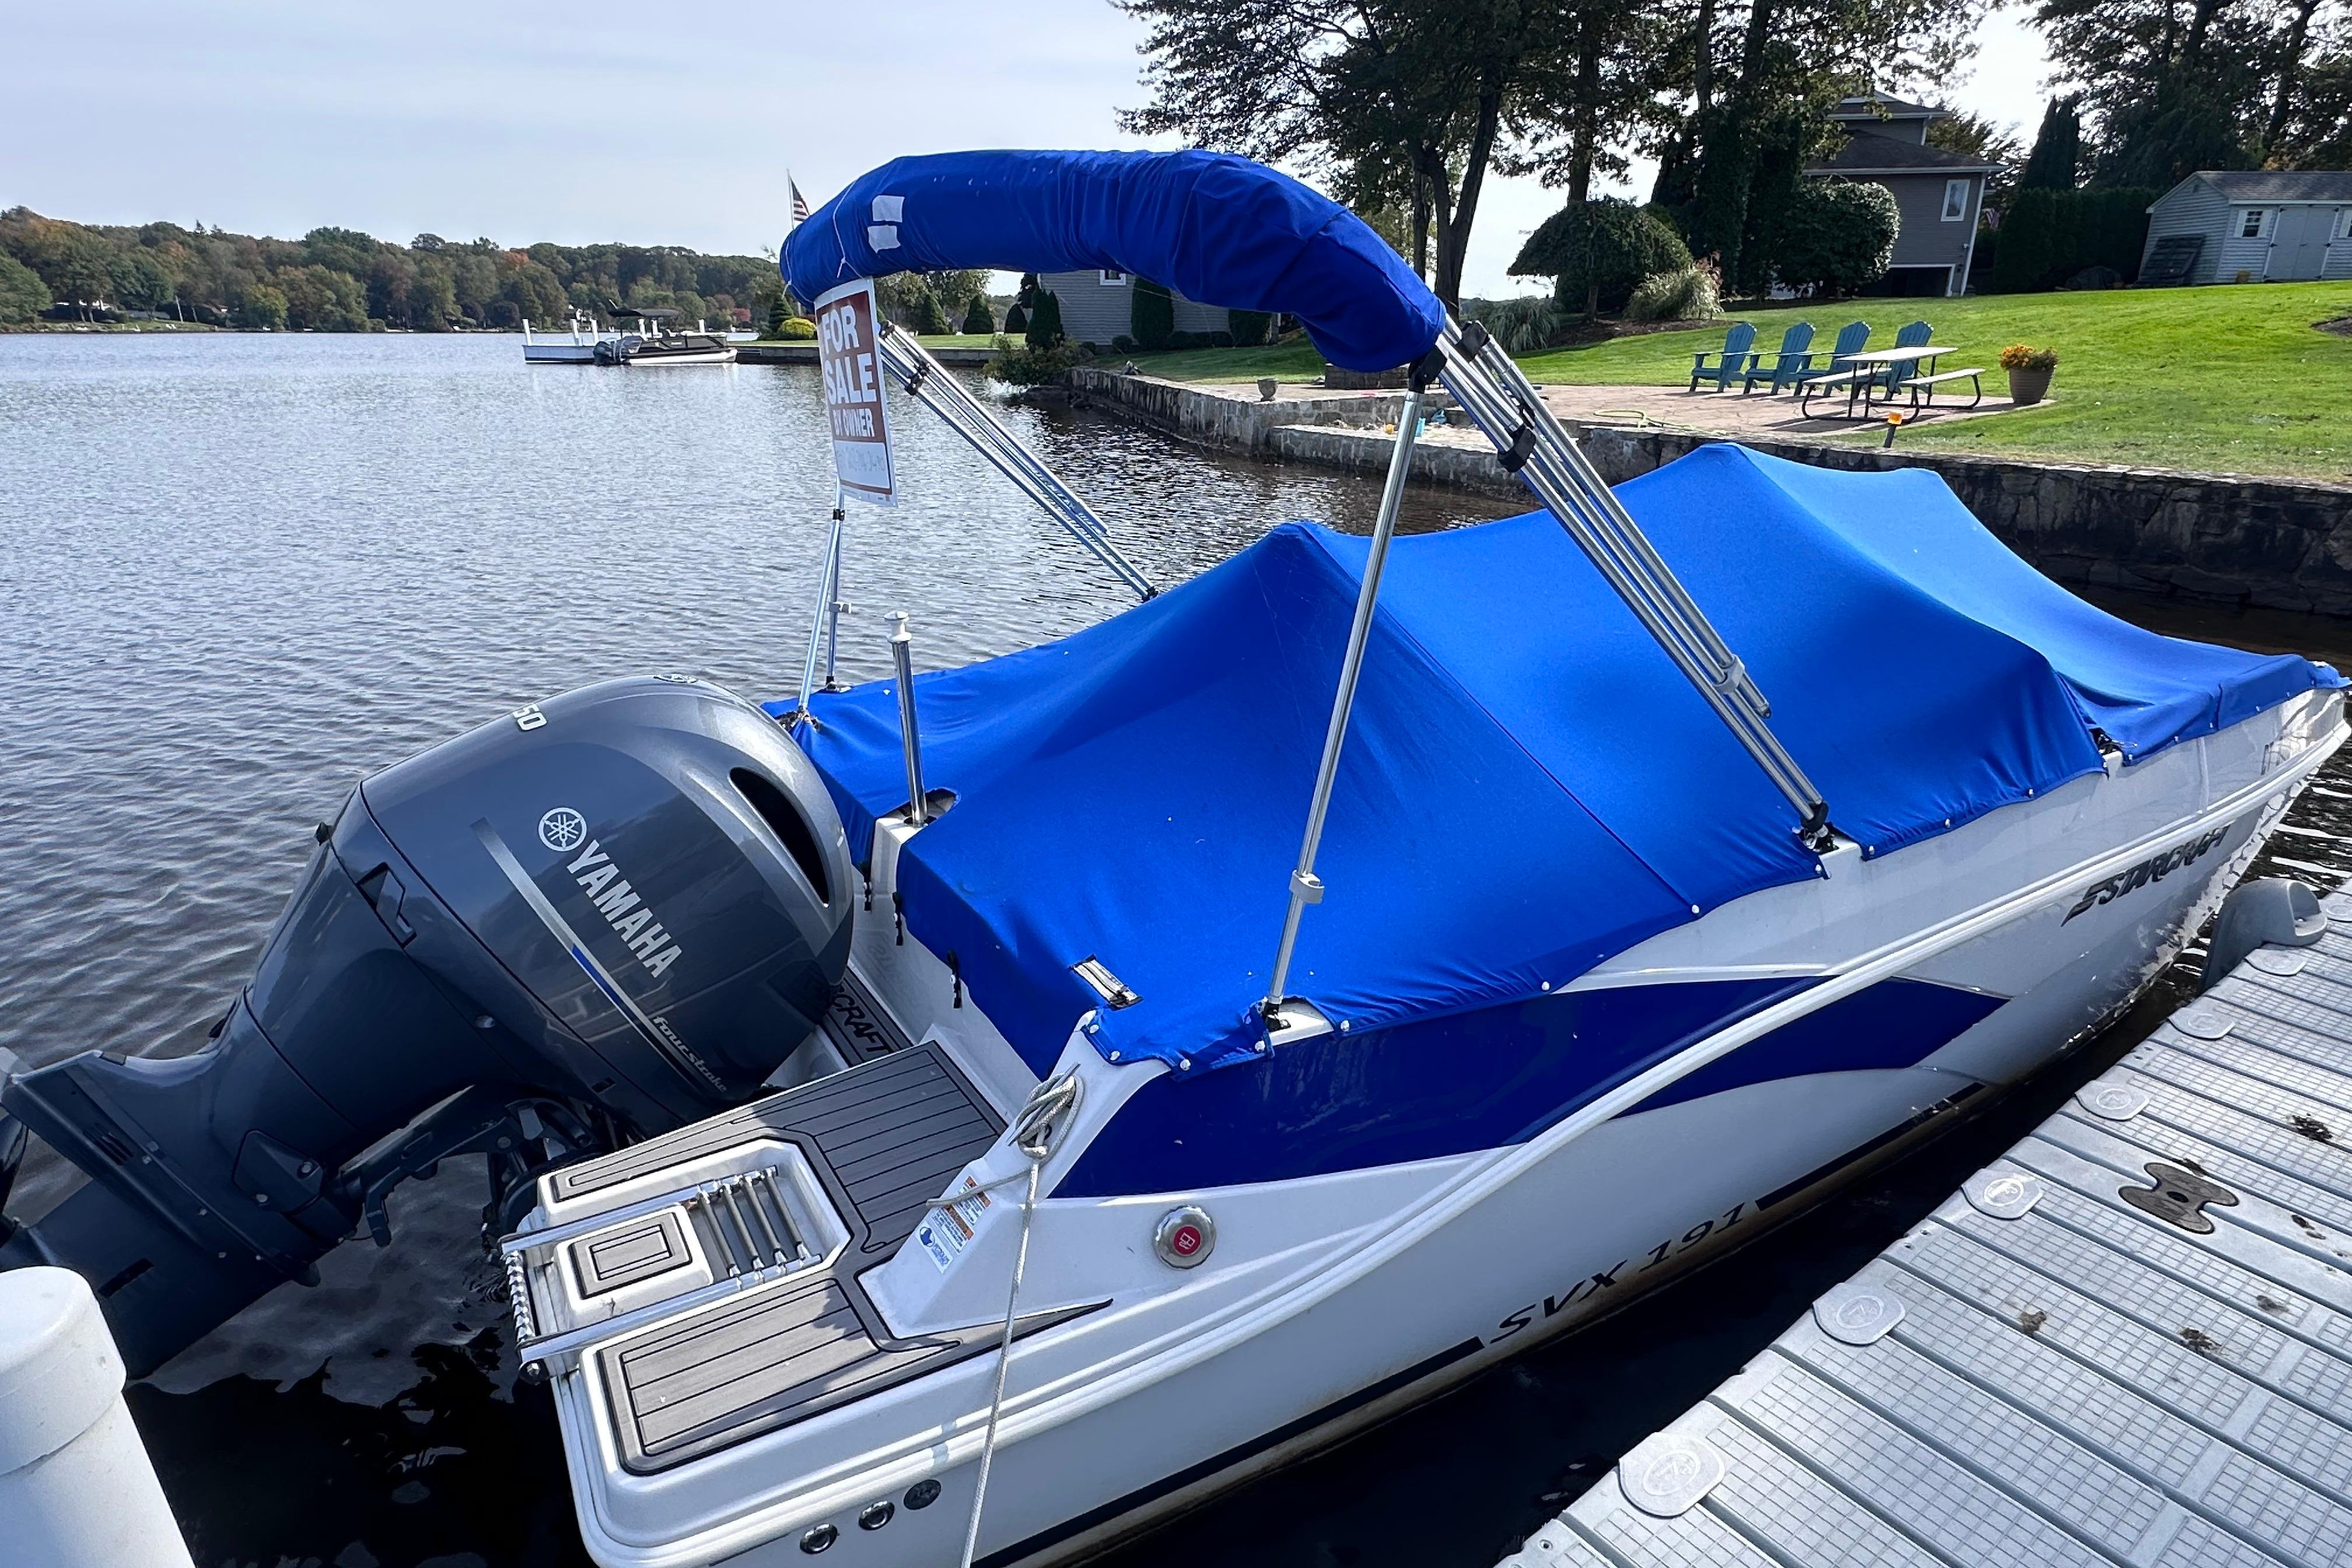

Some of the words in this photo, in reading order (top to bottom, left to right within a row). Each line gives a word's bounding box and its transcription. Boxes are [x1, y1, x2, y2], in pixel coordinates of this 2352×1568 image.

[822, 304, 859, 354] FOR
[825, 352, 877, 405] SALE
[833, 409, 844, 436] BY
[844, 408, 875, 438] OWNER
[566, 839, 683, 978] YAMAHA
[1489, 1259, 1628, 1343] SVX
[1639, 1202, 1745, 1272] 191
